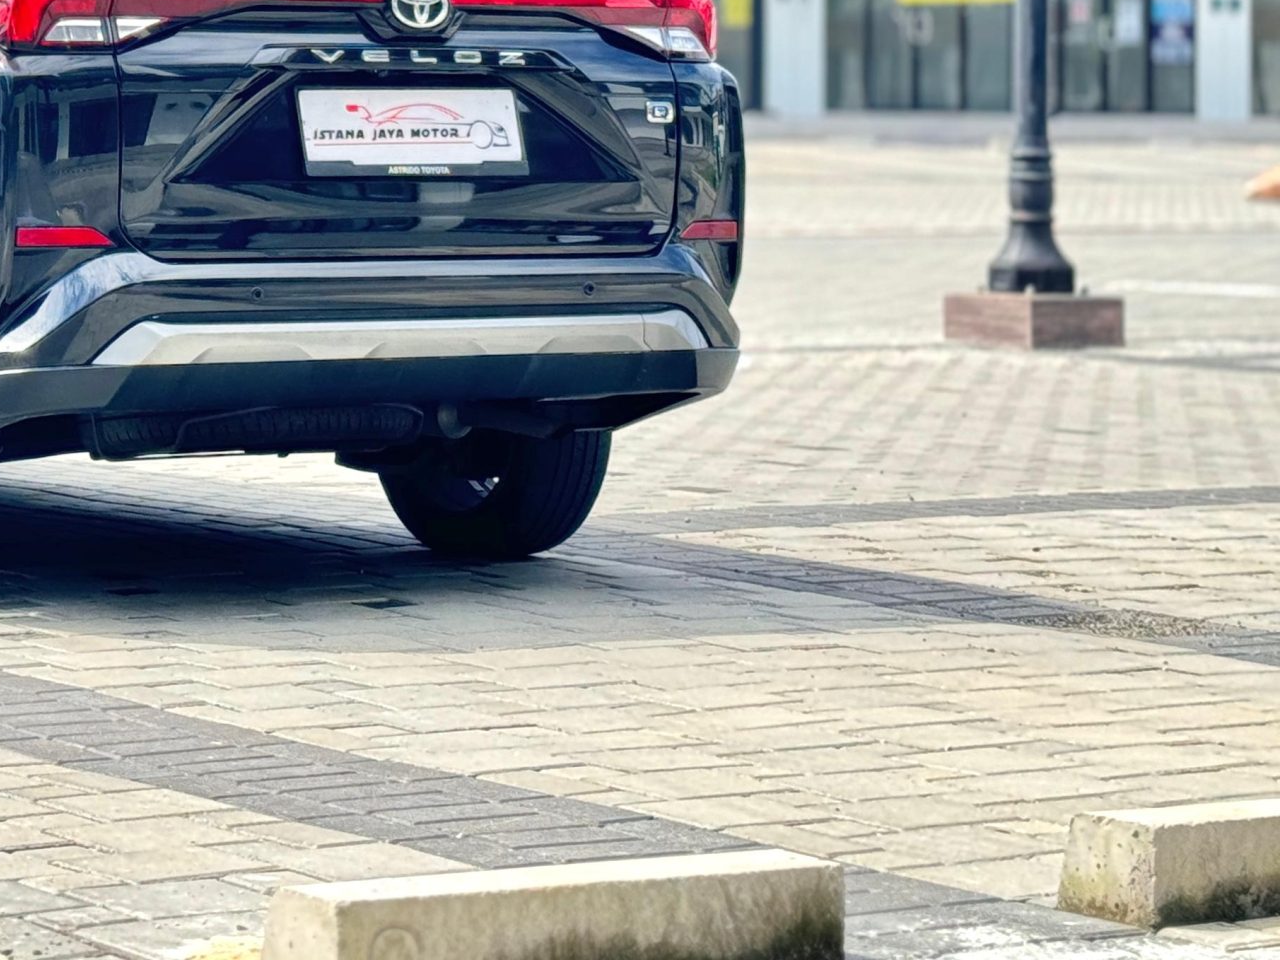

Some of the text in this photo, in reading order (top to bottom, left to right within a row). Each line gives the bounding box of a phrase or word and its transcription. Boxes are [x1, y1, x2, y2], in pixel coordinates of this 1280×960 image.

[311, 49, 526, 66] VELOZ
[314, 127, 459, 141] ISTANA JAYA MOTOR
[421, 166, 450, 174] TOYOTA
